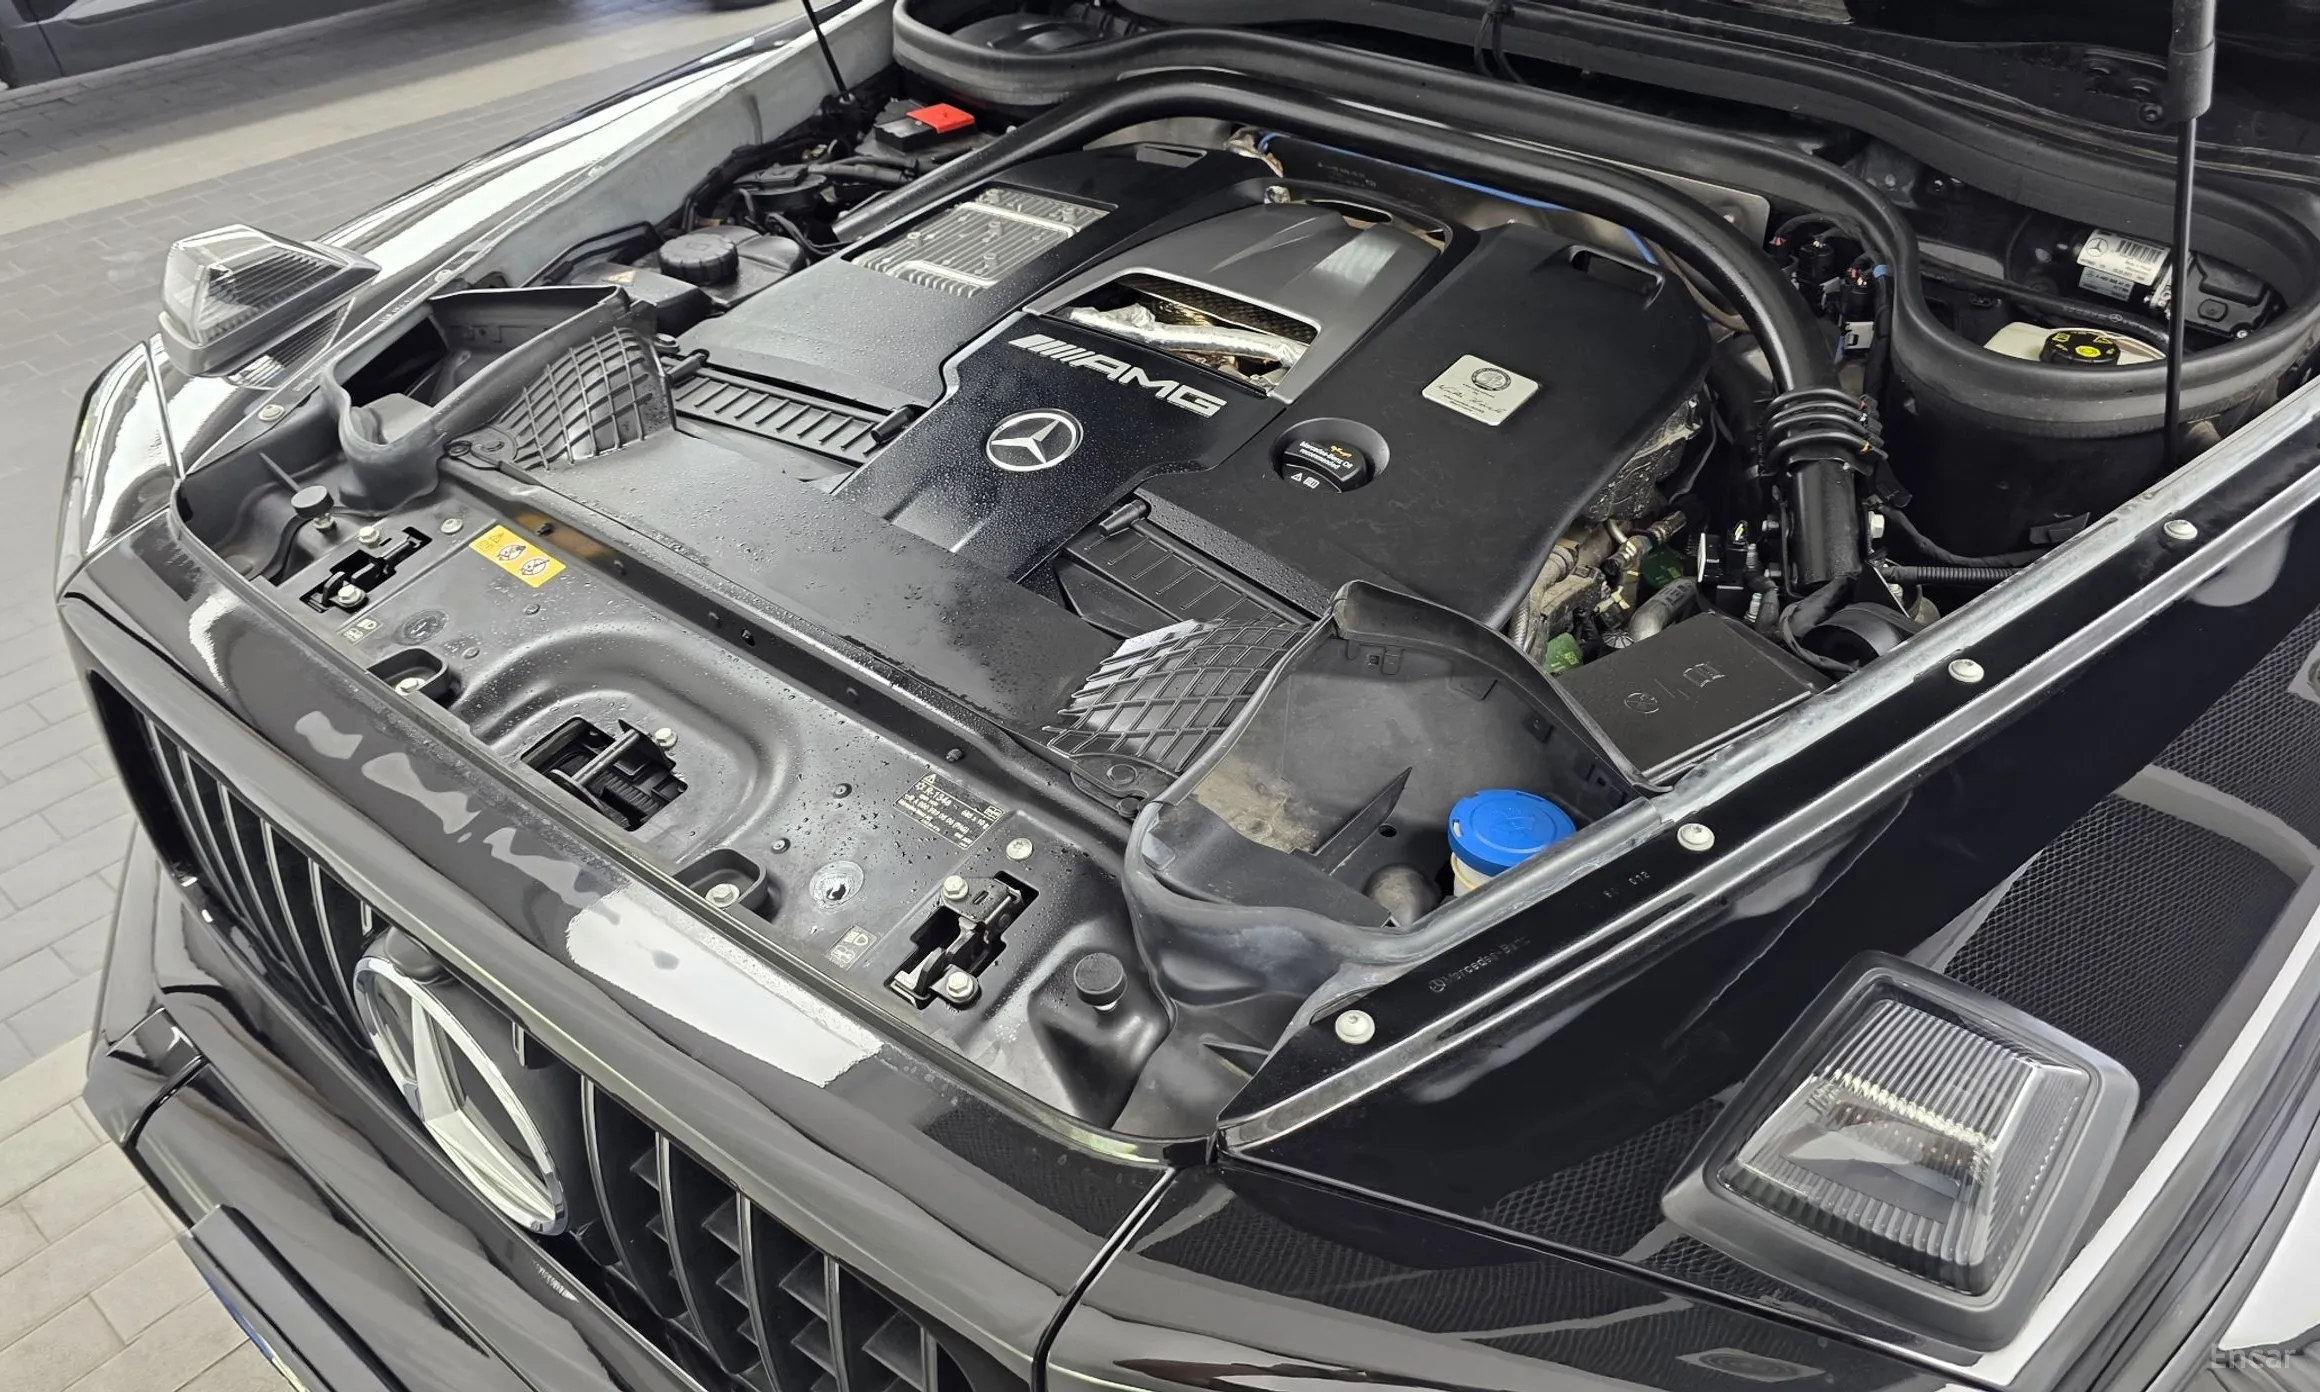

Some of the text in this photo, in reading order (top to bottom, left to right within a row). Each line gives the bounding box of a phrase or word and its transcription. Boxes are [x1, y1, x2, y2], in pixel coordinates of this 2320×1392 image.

[1069, 354, 1227, 419] AMG
[1299, 441, 1344, 464] Mercedes-Benz
[1299, 448, 1341, 470] recommended
